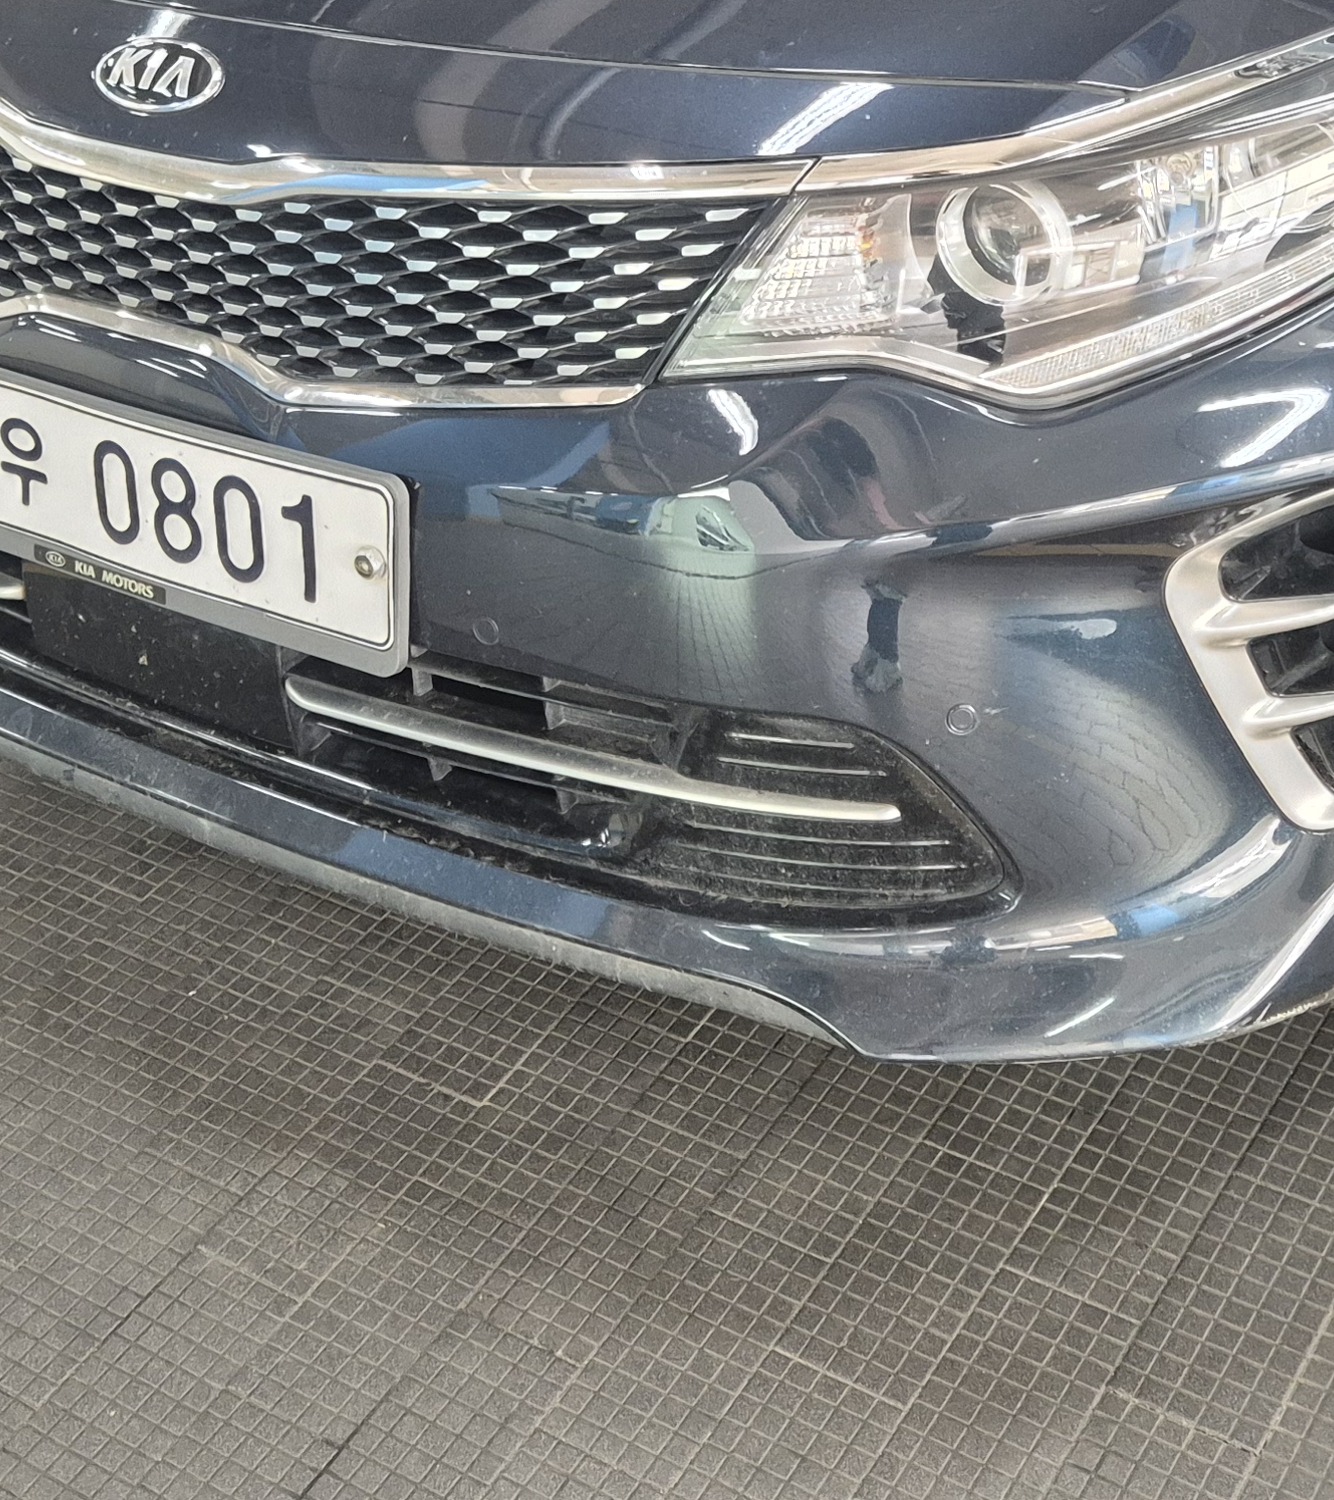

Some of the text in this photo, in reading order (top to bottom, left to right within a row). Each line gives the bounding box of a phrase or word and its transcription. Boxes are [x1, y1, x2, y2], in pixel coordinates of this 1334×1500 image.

[106, 47, 196, 99] KIA
[93, 439, 317, 604] 0801
[74, 560, 155, 599] KIA MOTORS
